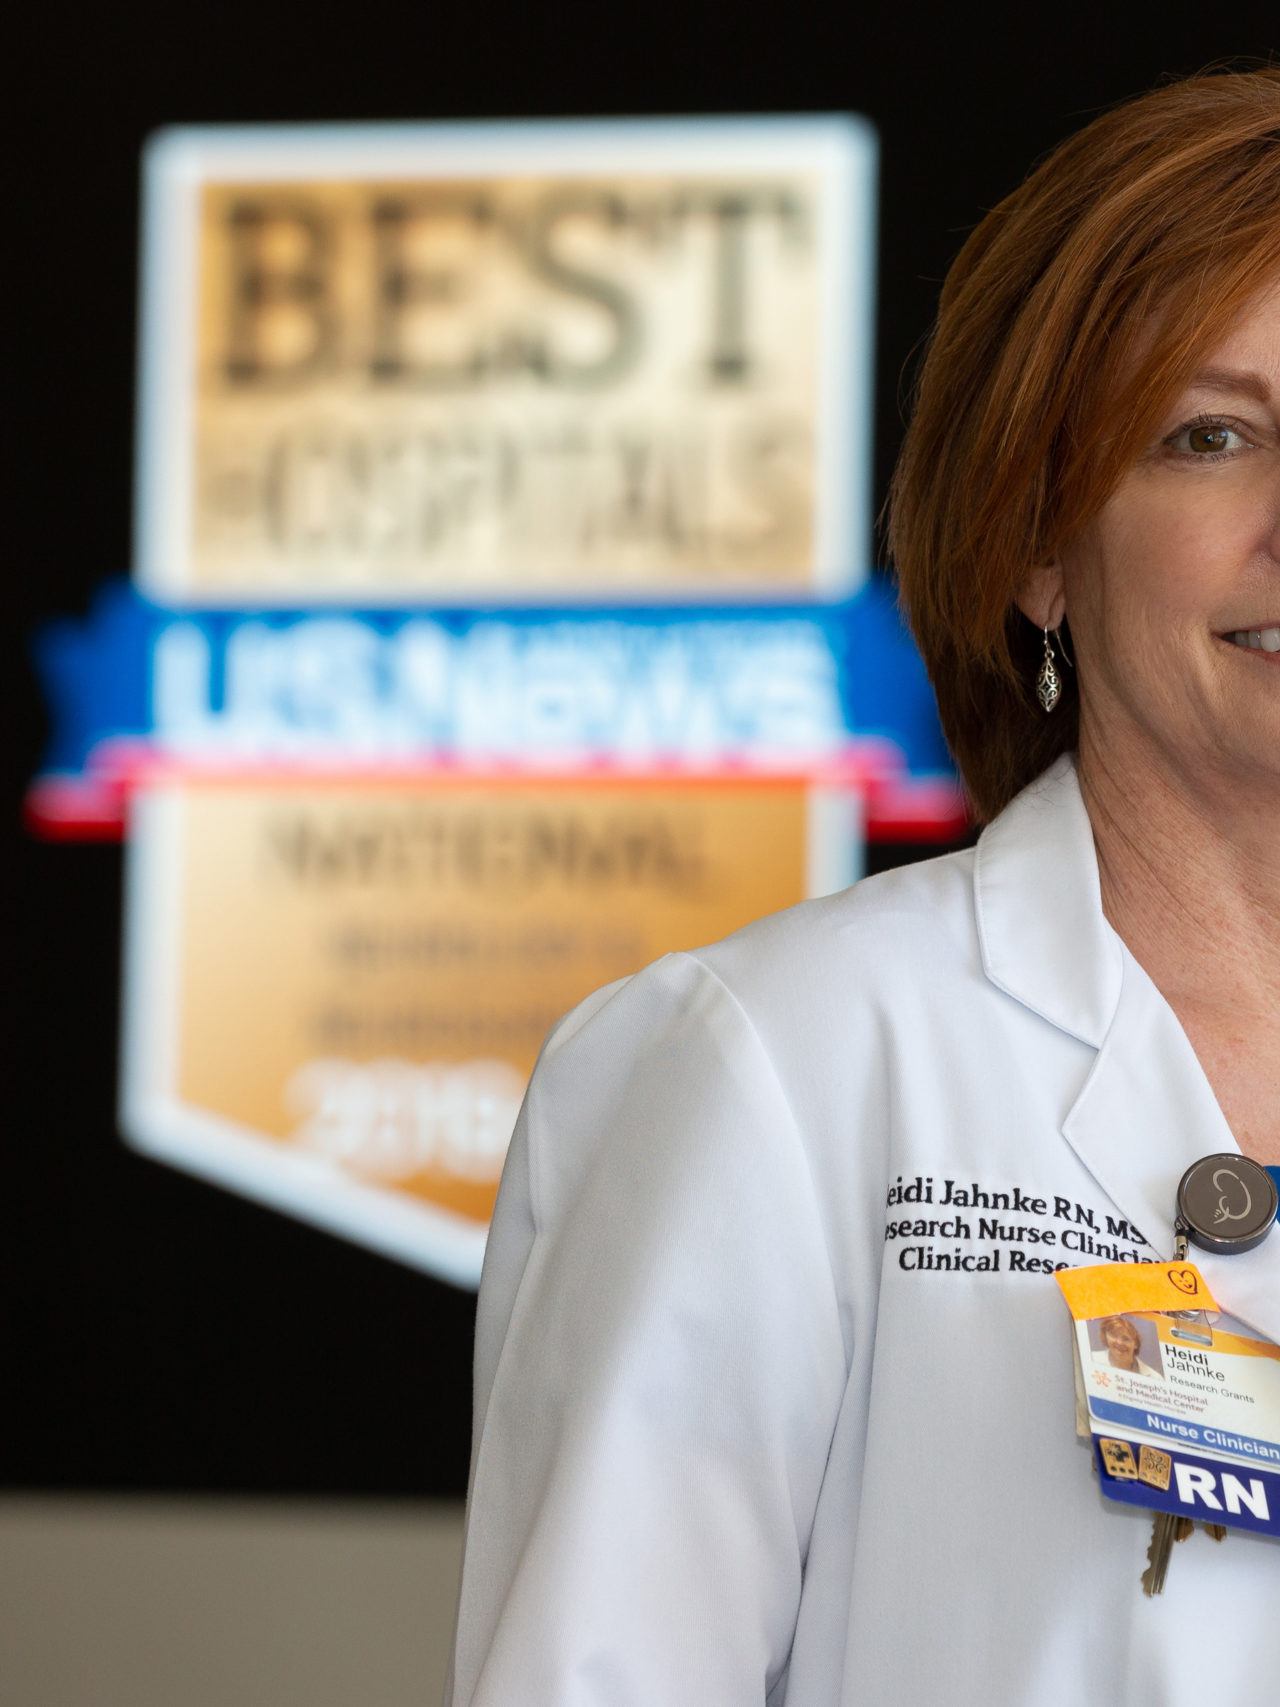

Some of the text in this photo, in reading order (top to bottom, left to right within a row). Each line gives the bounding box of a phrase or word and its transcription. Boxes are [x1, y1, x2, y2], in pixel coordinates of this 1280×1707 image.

[222, 183, 815, 390] BEST
[886, 1175, 1151, 1247] eidi Jahnke RN, MS
[884, 1215, 971, 1243] search
[978, 1217, 1057, 1248] Nurse
[898, 1246, 1001, 1273] Clinical
[1165, 1344, 1209, 1367] Heidi
[1166, 1359, 1226, 1382] Jahnke
[1116, 1385, 1133, 1395] and
[1135, 1387, 1172, 1405] Medical
[1172, 1398, 1205, 1413] Center
[1129, 1377, 1168, 1395] Joseph's
[1168, 1388, 1209, 1407] Hospital
[1169, 1374, 1256, 1405] Research Grants
[1147, 1413, 1199, 1440] Nurse
[1173, 1461, 1271, 1521] RN
